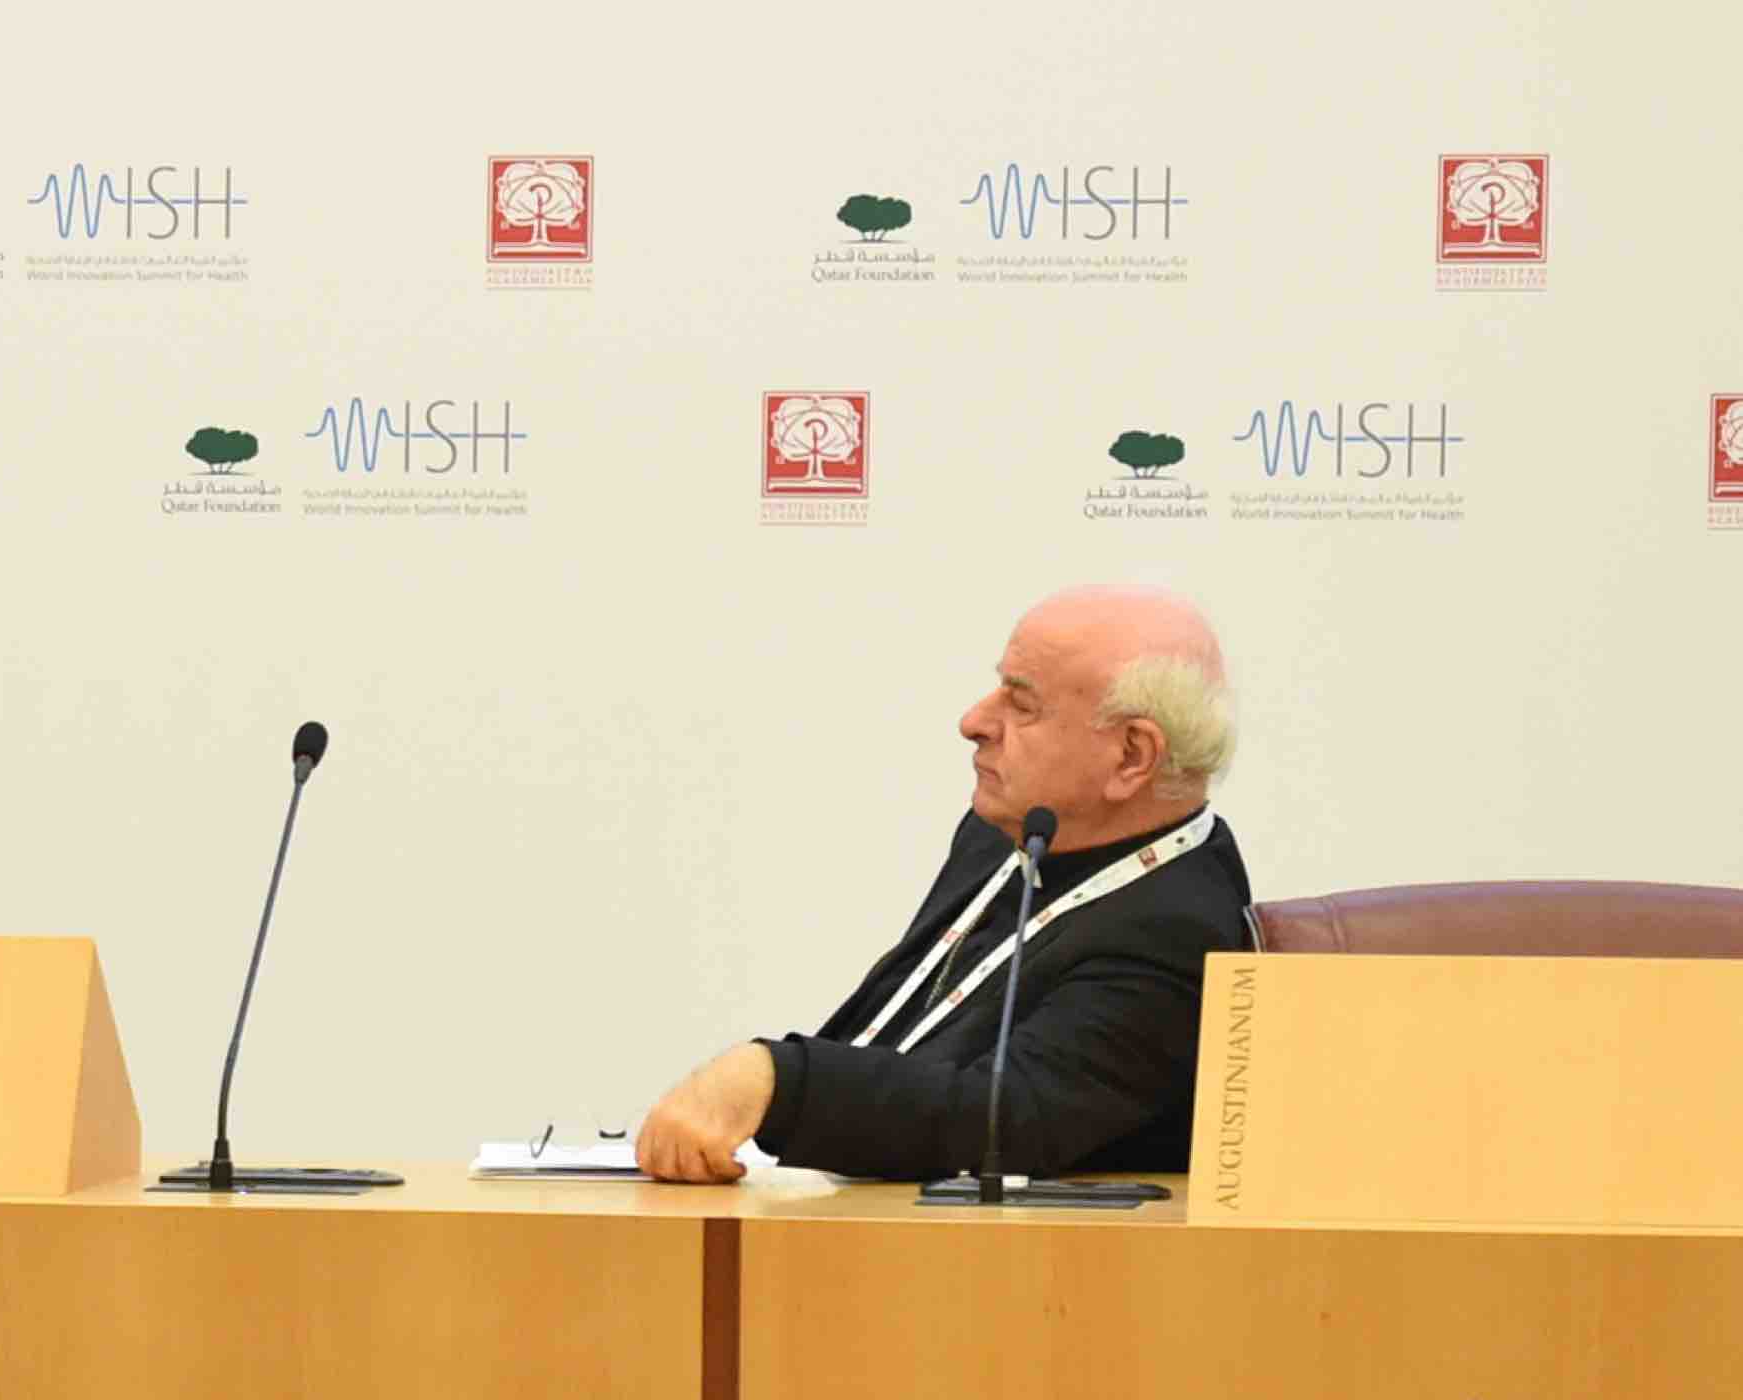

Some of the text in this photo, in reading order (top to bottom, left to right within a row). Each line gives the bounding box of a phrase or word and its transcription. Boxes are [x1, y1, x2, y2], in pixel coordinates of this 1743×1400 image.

[27, 163, 248, 240] WISH
[959, 163, 1189, 241] WISH
[811, 266, 935, 285] Qatar Foundation
[304, 397, 528, 474] WISH
[1232, 400, 1465, 478] WISH
[161, 498, 281, 516] Qatar Foundation
[1083, 503, 1207, 522] Qatar Foundation
[1217, 967, 1257, 1211] AUGUSTINIANUM
